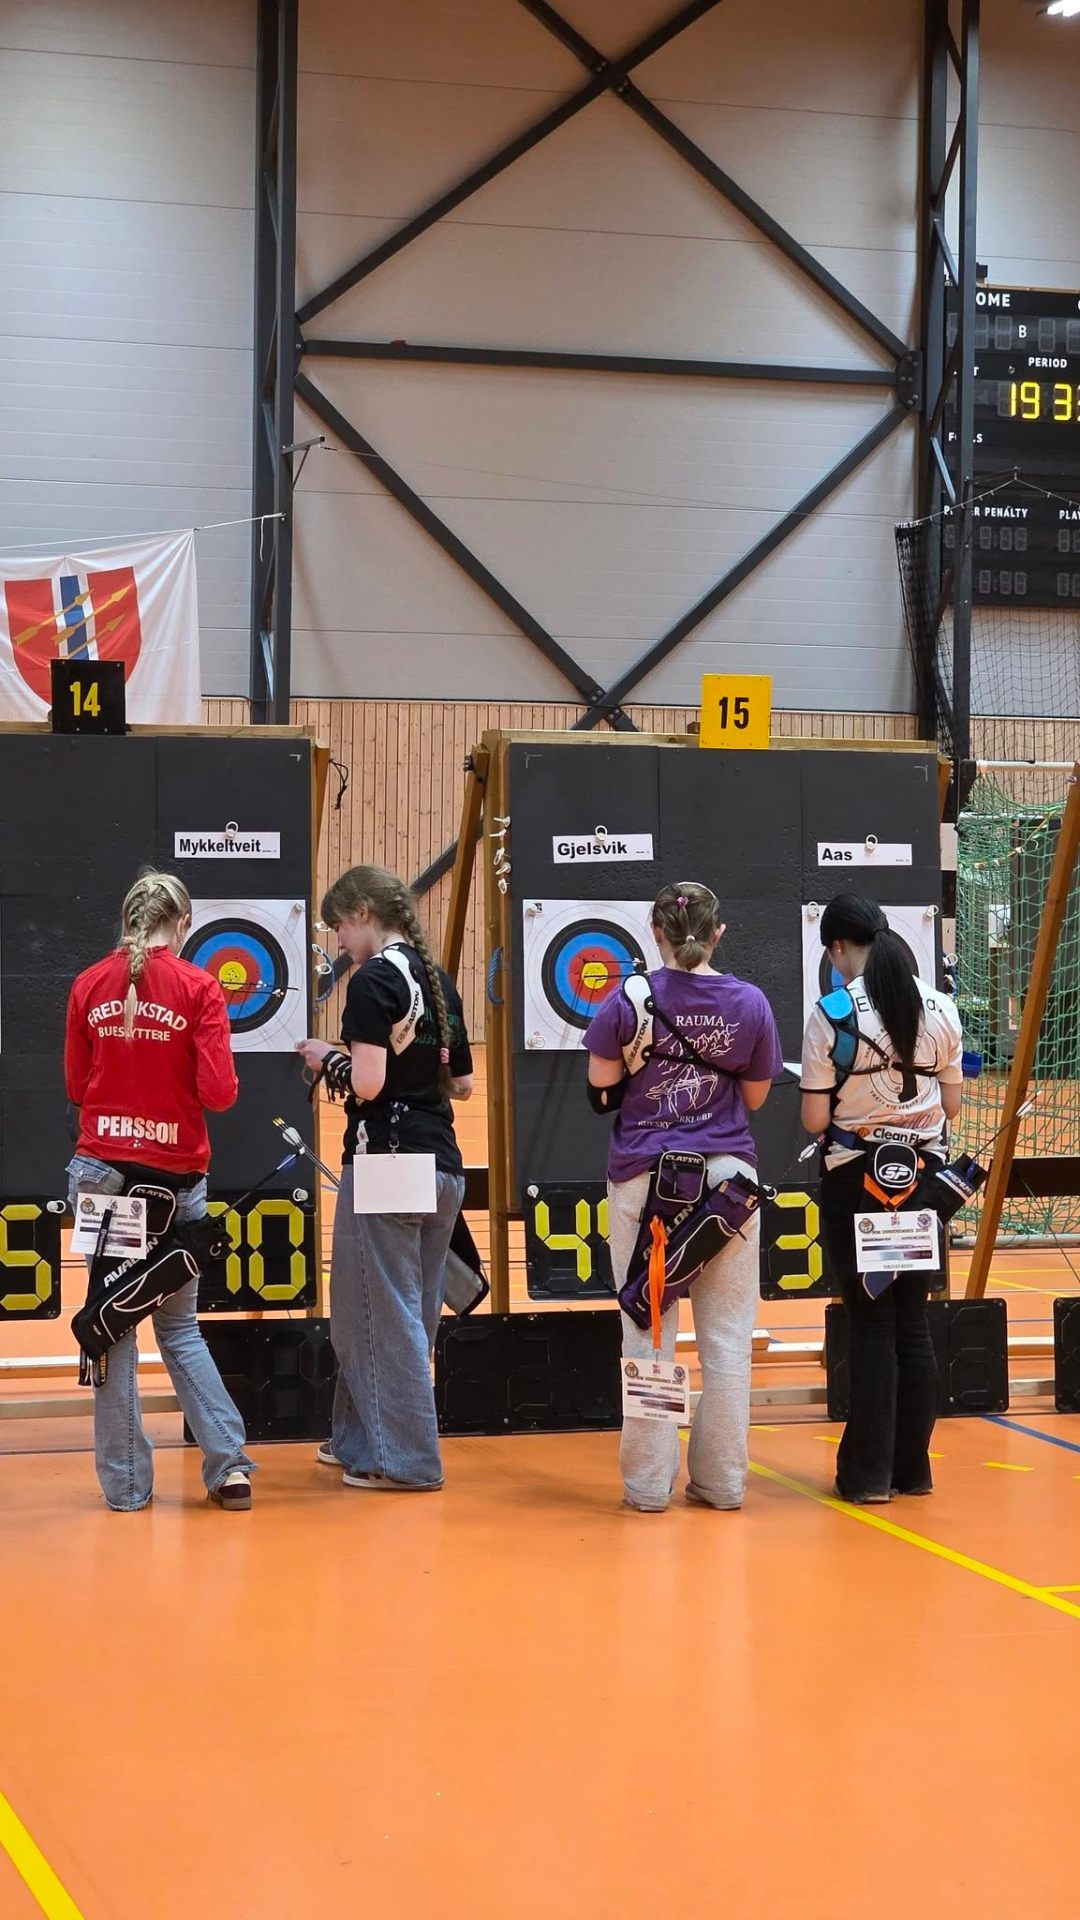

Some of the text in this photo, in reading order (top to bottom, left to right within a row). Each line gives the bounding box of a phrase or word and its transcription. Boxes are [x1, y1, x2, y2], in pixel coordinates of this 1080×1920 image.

[975, 292, 1011, 307] OME
[1018, 325, 1027, 338] B
[1028, 357, 1068, 369] PERIOD
[1010, 382, 1080, 420] 19 3
[984, 507, 1028, 518] PENALTY
[70, 681, 101, 717] 14
[718, 696, 750, 730] 15
[179, 838, 261, 856] Mykkeltveit
[557, 841, 628, 859] Gjelsvik
[822, 848, 853, 861] Aas
[87, 1000, 188, 1031] FREDIKSTAD
[675, 1015, 724, 1026] RAUMA
[98, 1026, 171, 1042] BUESYTTERE
[97, 1115, 179, 1144] PERSSON
[103, 1236, 158, 1288] AVALN
